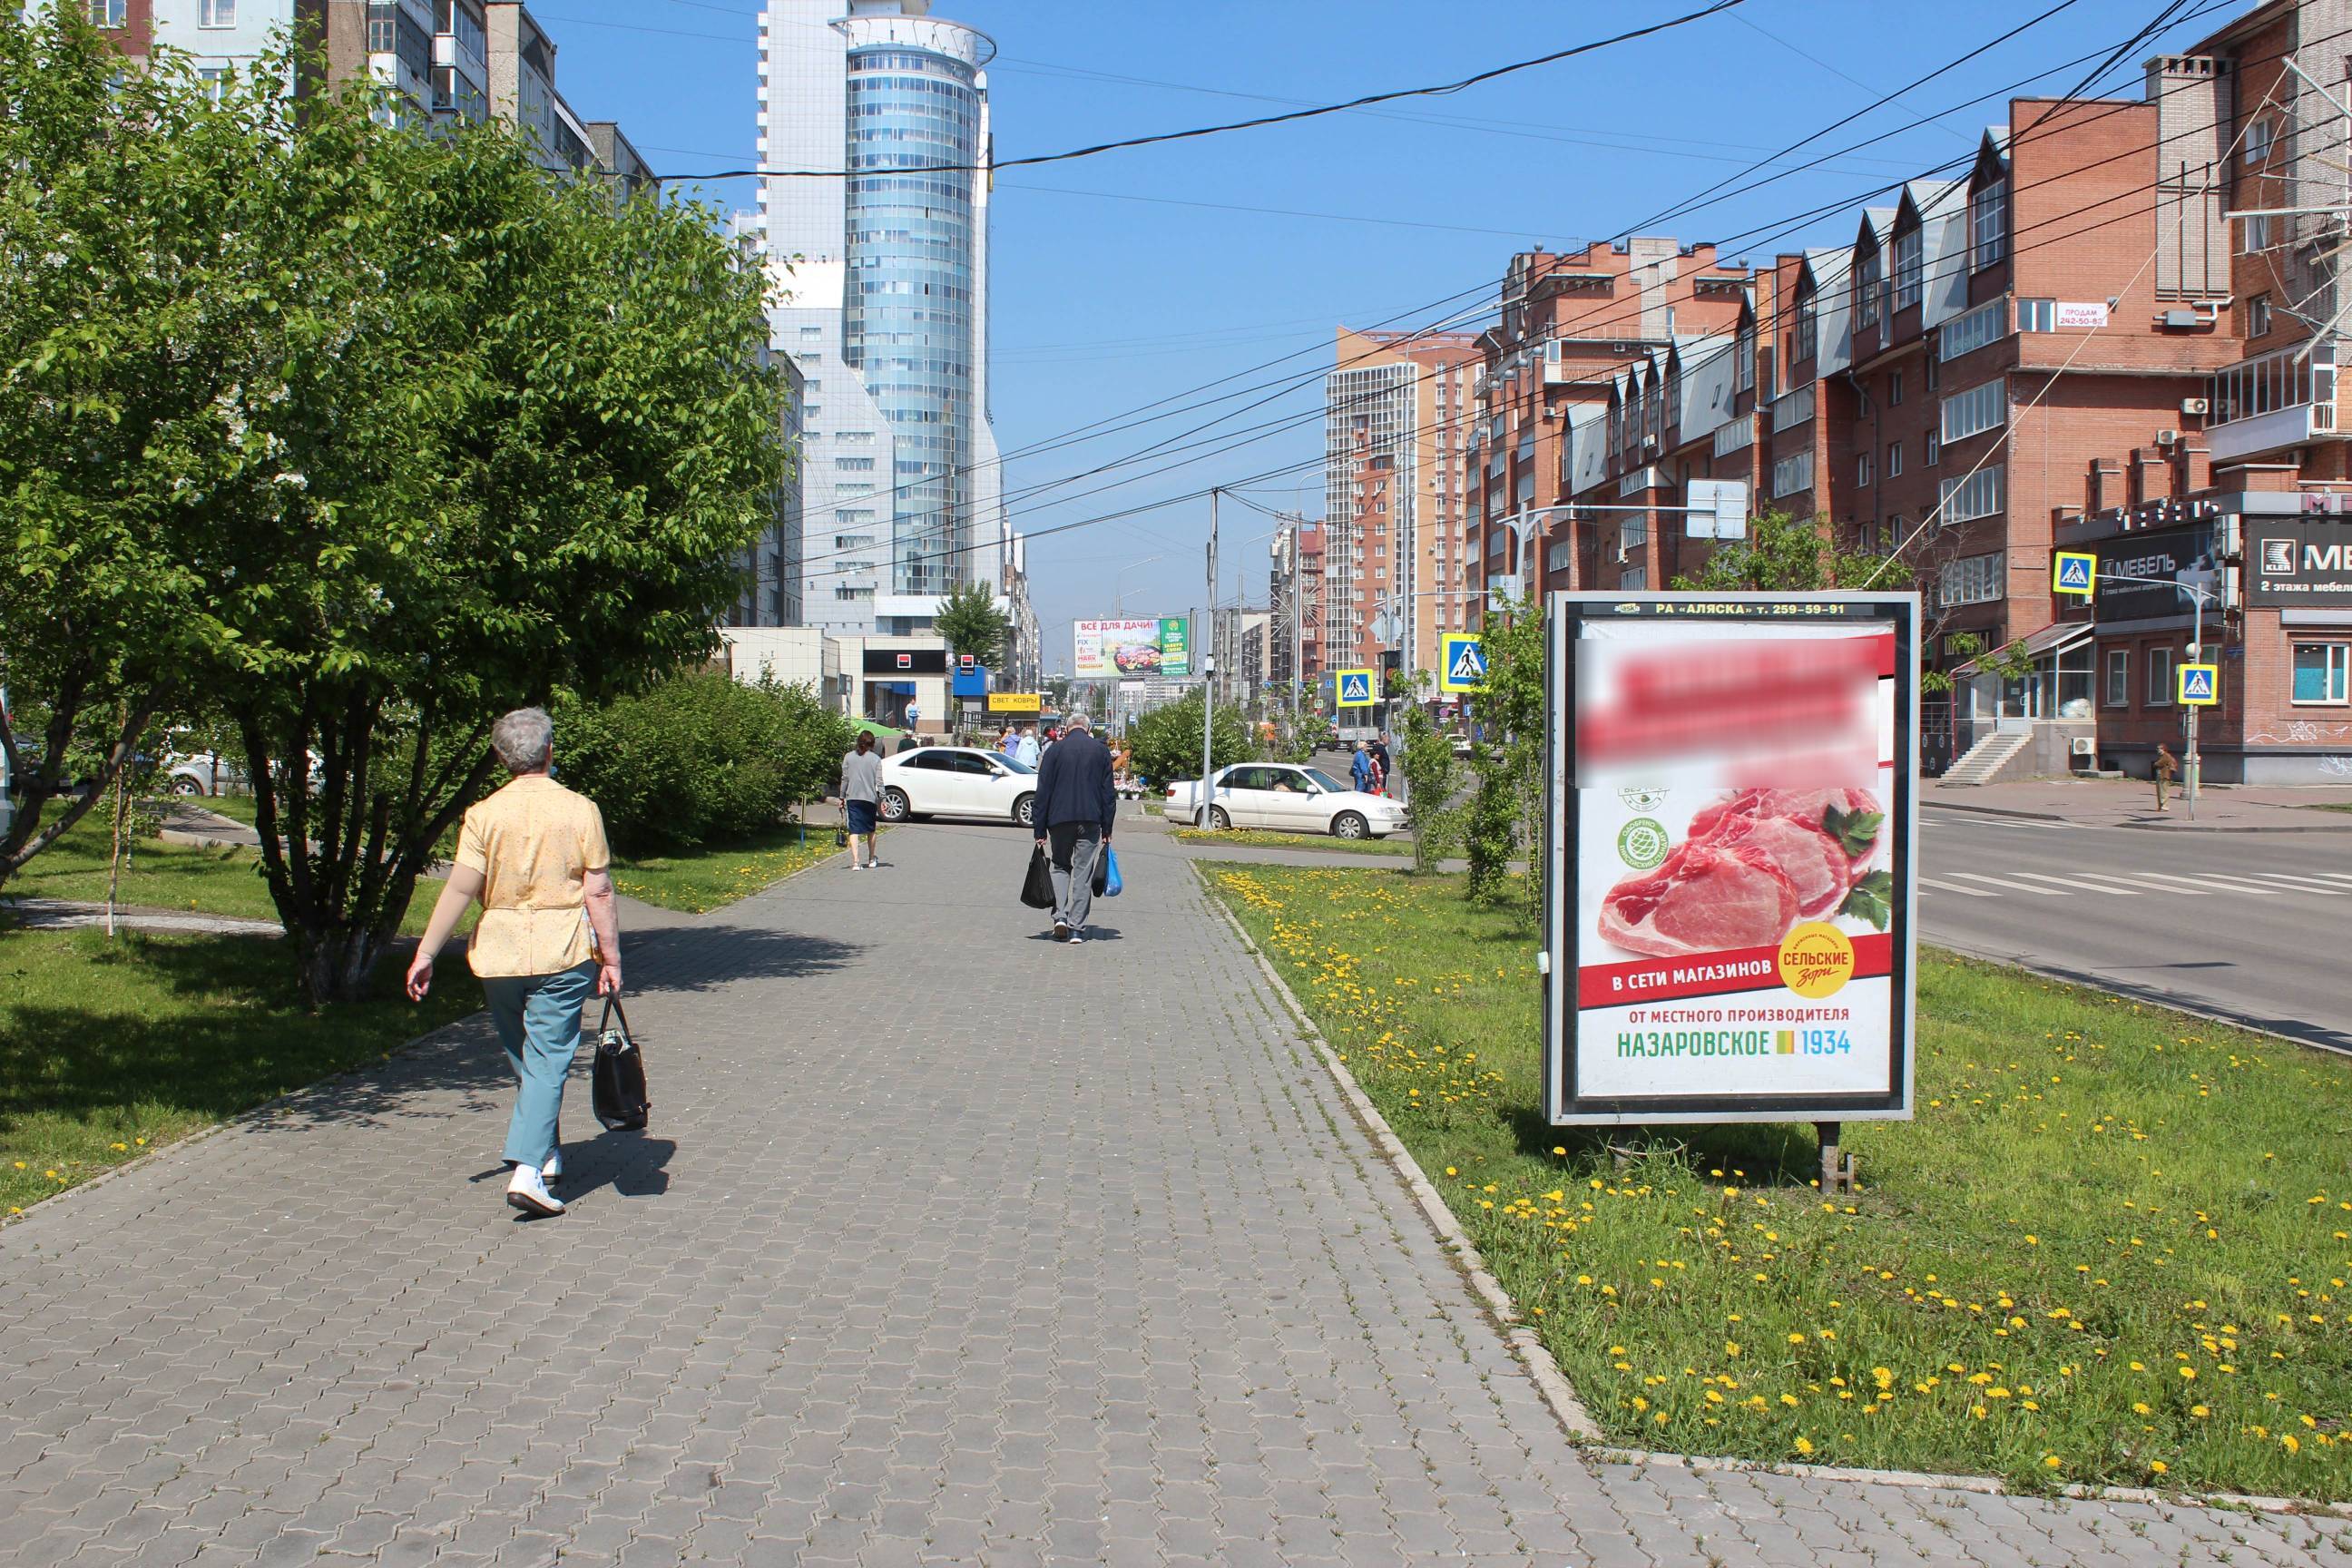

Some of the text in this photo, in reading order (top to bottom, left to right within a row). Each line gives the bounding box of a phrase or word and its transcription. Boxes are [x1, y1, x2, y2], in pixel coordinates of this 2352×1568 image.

[2115, 553, 2176, 577] МЕБЕЛЬ
[2260, 581, 2270, 592] 2
[2273, 583, 2309, 592] этажа
[1656, 603, 1845, 614] РА «АЛЯСКА» т. 259-59-91
[1081, 621, 1153, 631] ВСЁ ДЛЯ ДАЧИ!
[1783, 952, 1848, 966] СЕЛЬСКИЕ
[1612, 959, 1772, 991] В СЕТИ МАГАЗИНОВ
[1629, 1007, 1850, 1024] ОТ МЕСТНОГО ПРОИЗВОДИТЕЛЯ
[1617, 1029, 1851, 1058] НАЗАРОВСКОЕ 1934
